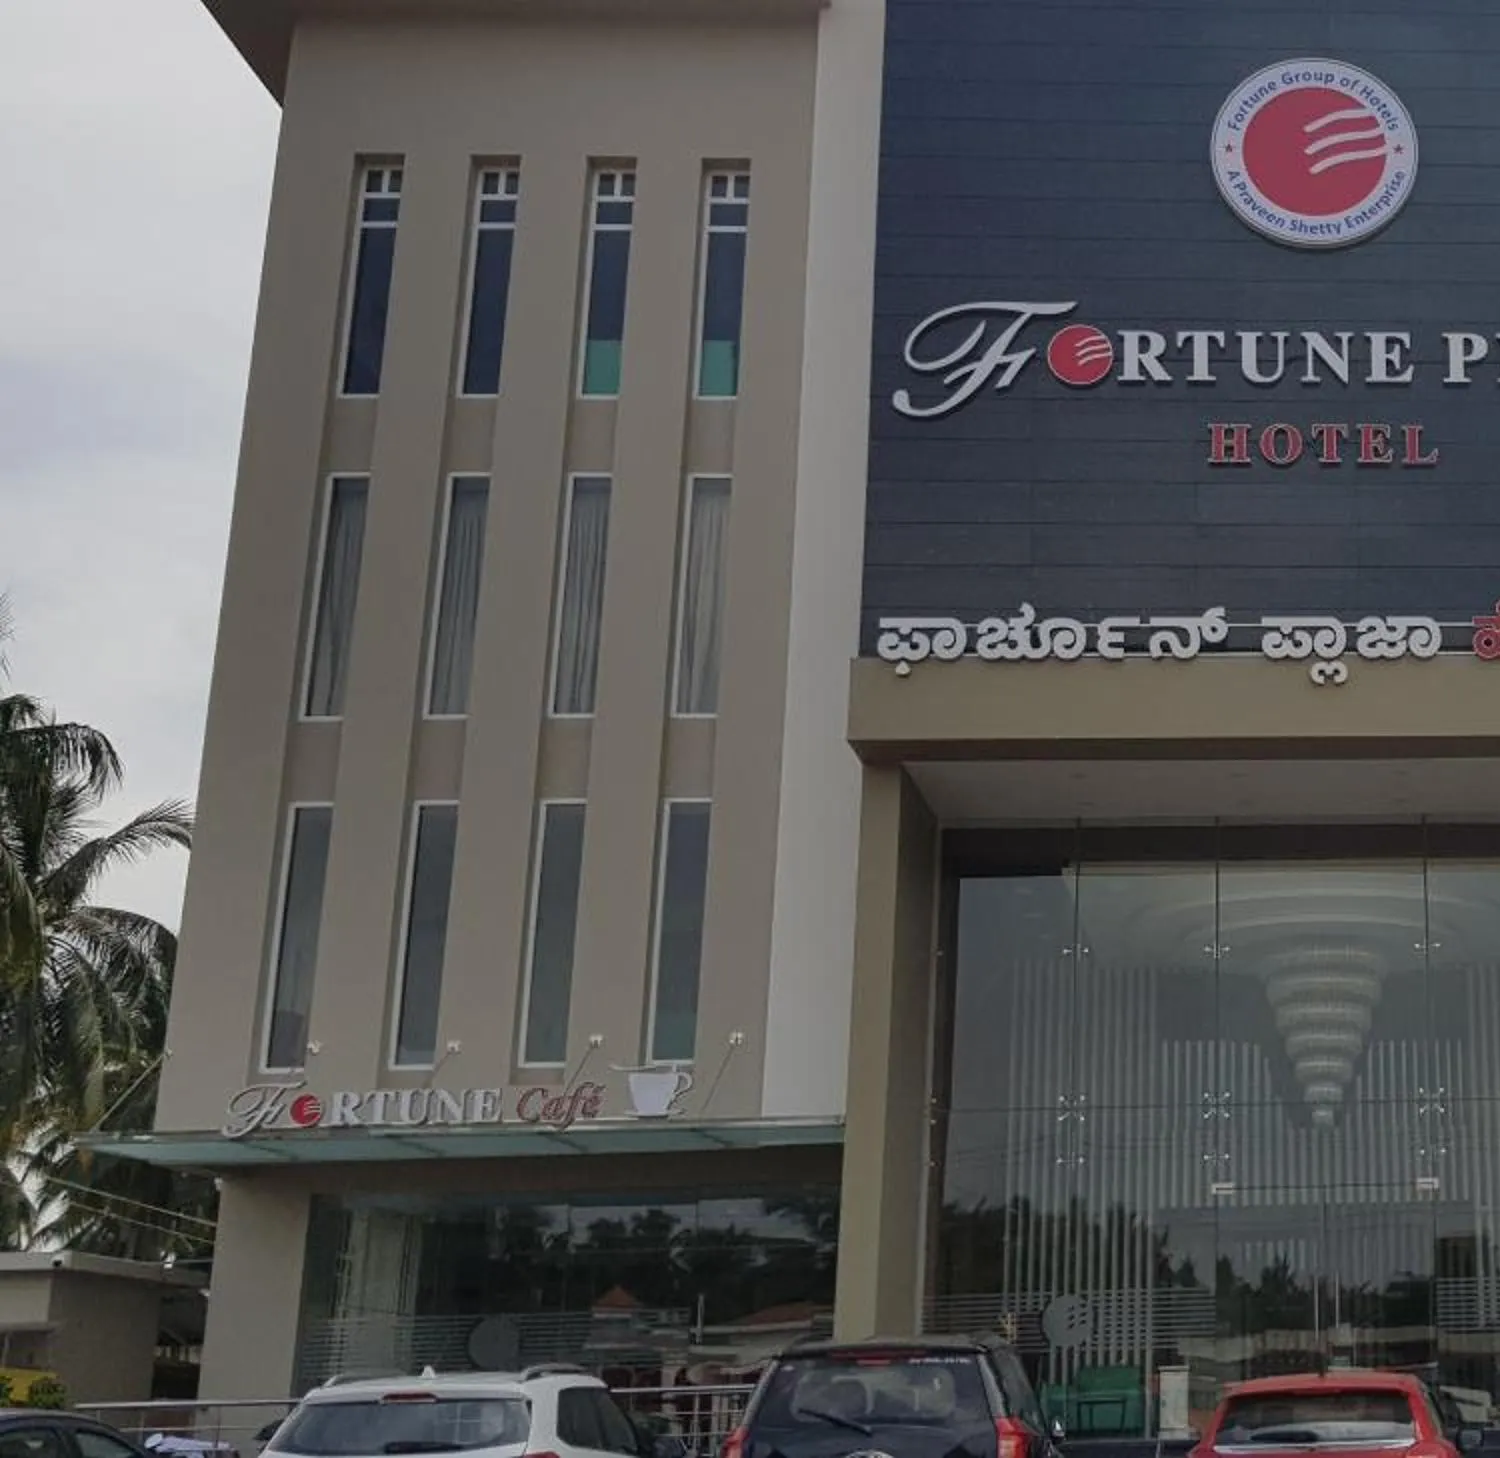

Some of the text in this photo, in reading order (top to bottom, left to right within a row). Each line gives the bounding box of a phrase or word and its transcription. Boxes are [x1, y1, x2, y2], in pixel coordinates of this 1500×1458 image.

[1227, 70, 1400, 132] Fortune Group of Hotels
[1227, 169, 1406, 236] A Praveen Shetty Enterprise
[1207, 422, 1440, 467] HOTEL
[1261, 615, 1442, 685] ಪ್ಲಾಜಾ
